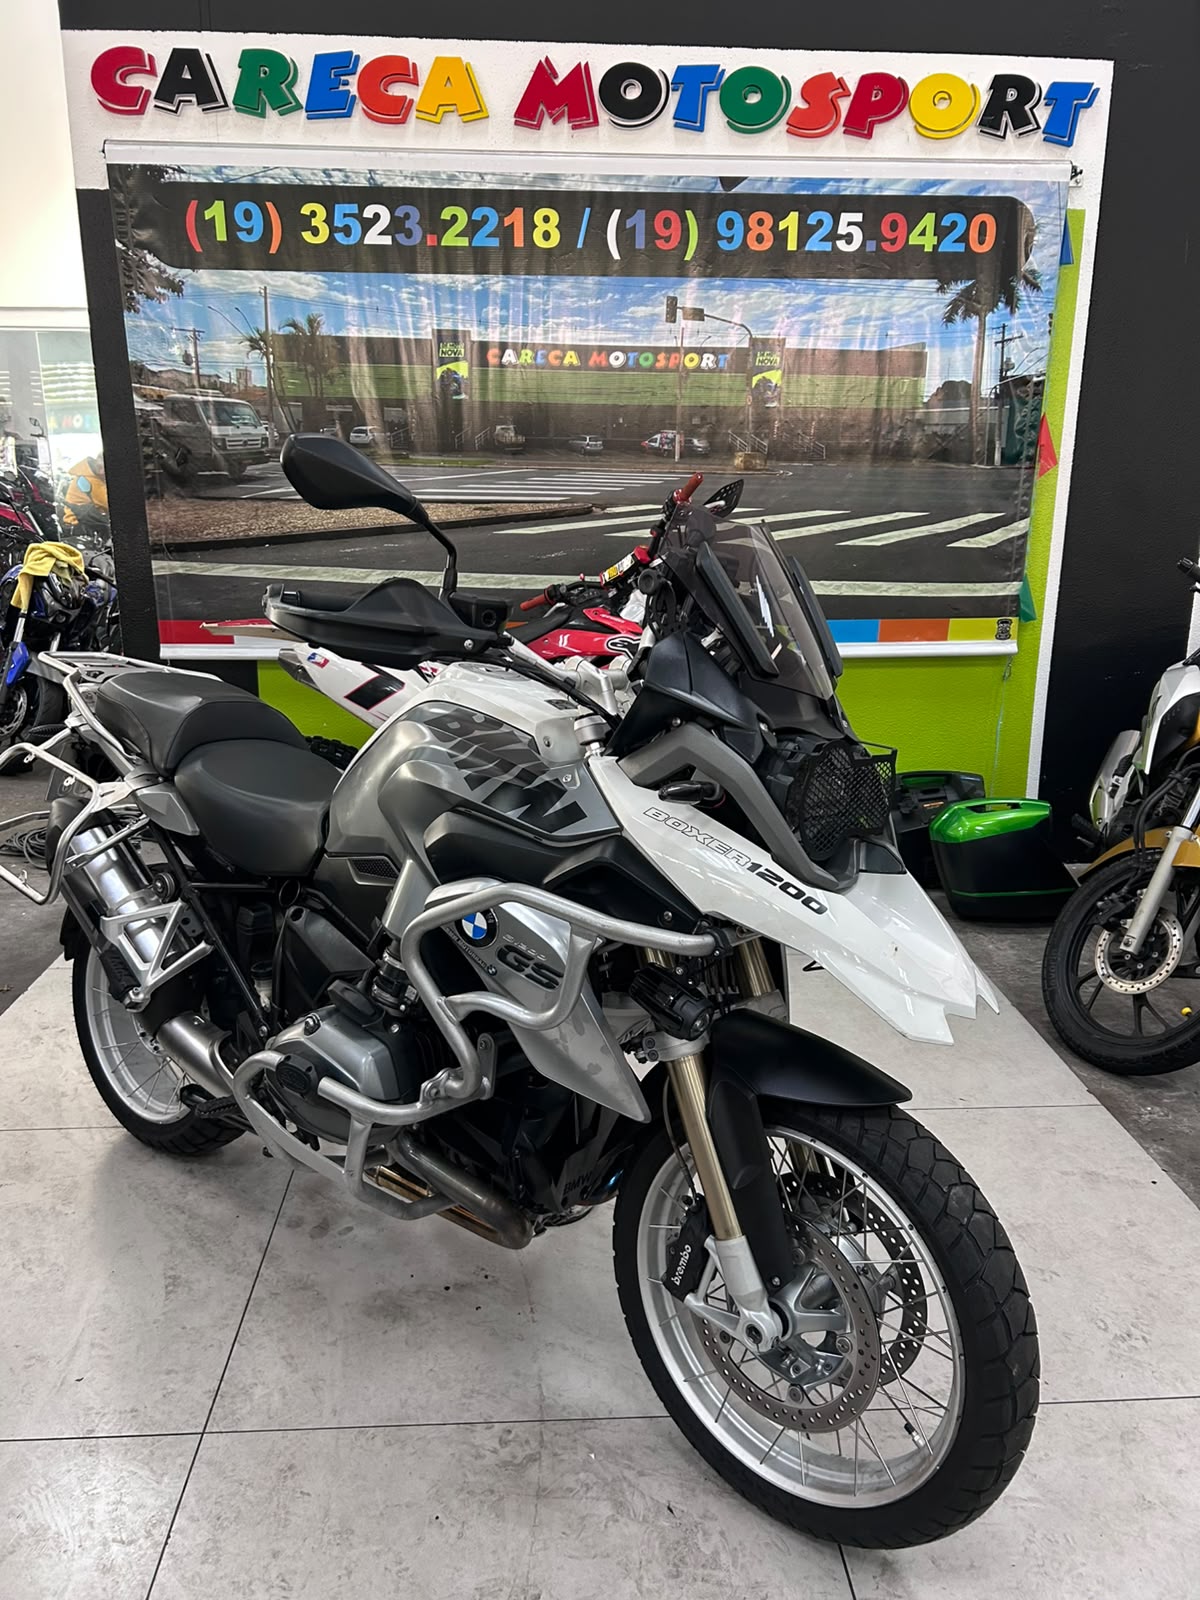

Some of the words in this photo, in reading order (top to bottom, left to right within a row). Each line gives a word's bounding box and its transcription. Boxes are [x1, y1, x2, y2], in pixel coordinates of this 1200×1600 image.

[91, 45, 489, 124] CARECA
[514, 55, 1100, 147] MOTOSPORT
[185, 200, 283, 254] (19)
[300, 203, 561, 248] 3523.2218
[606, 208, 699, 260] (19)
[716, 211, 997, 254] 98125.9420
[486, 348, 580, 367] CARECA
[588, 350, 729, 369] MOTOSPORT
[496, 944, 565, 990] GS
[671, 1244, 692, 1287] brembo
